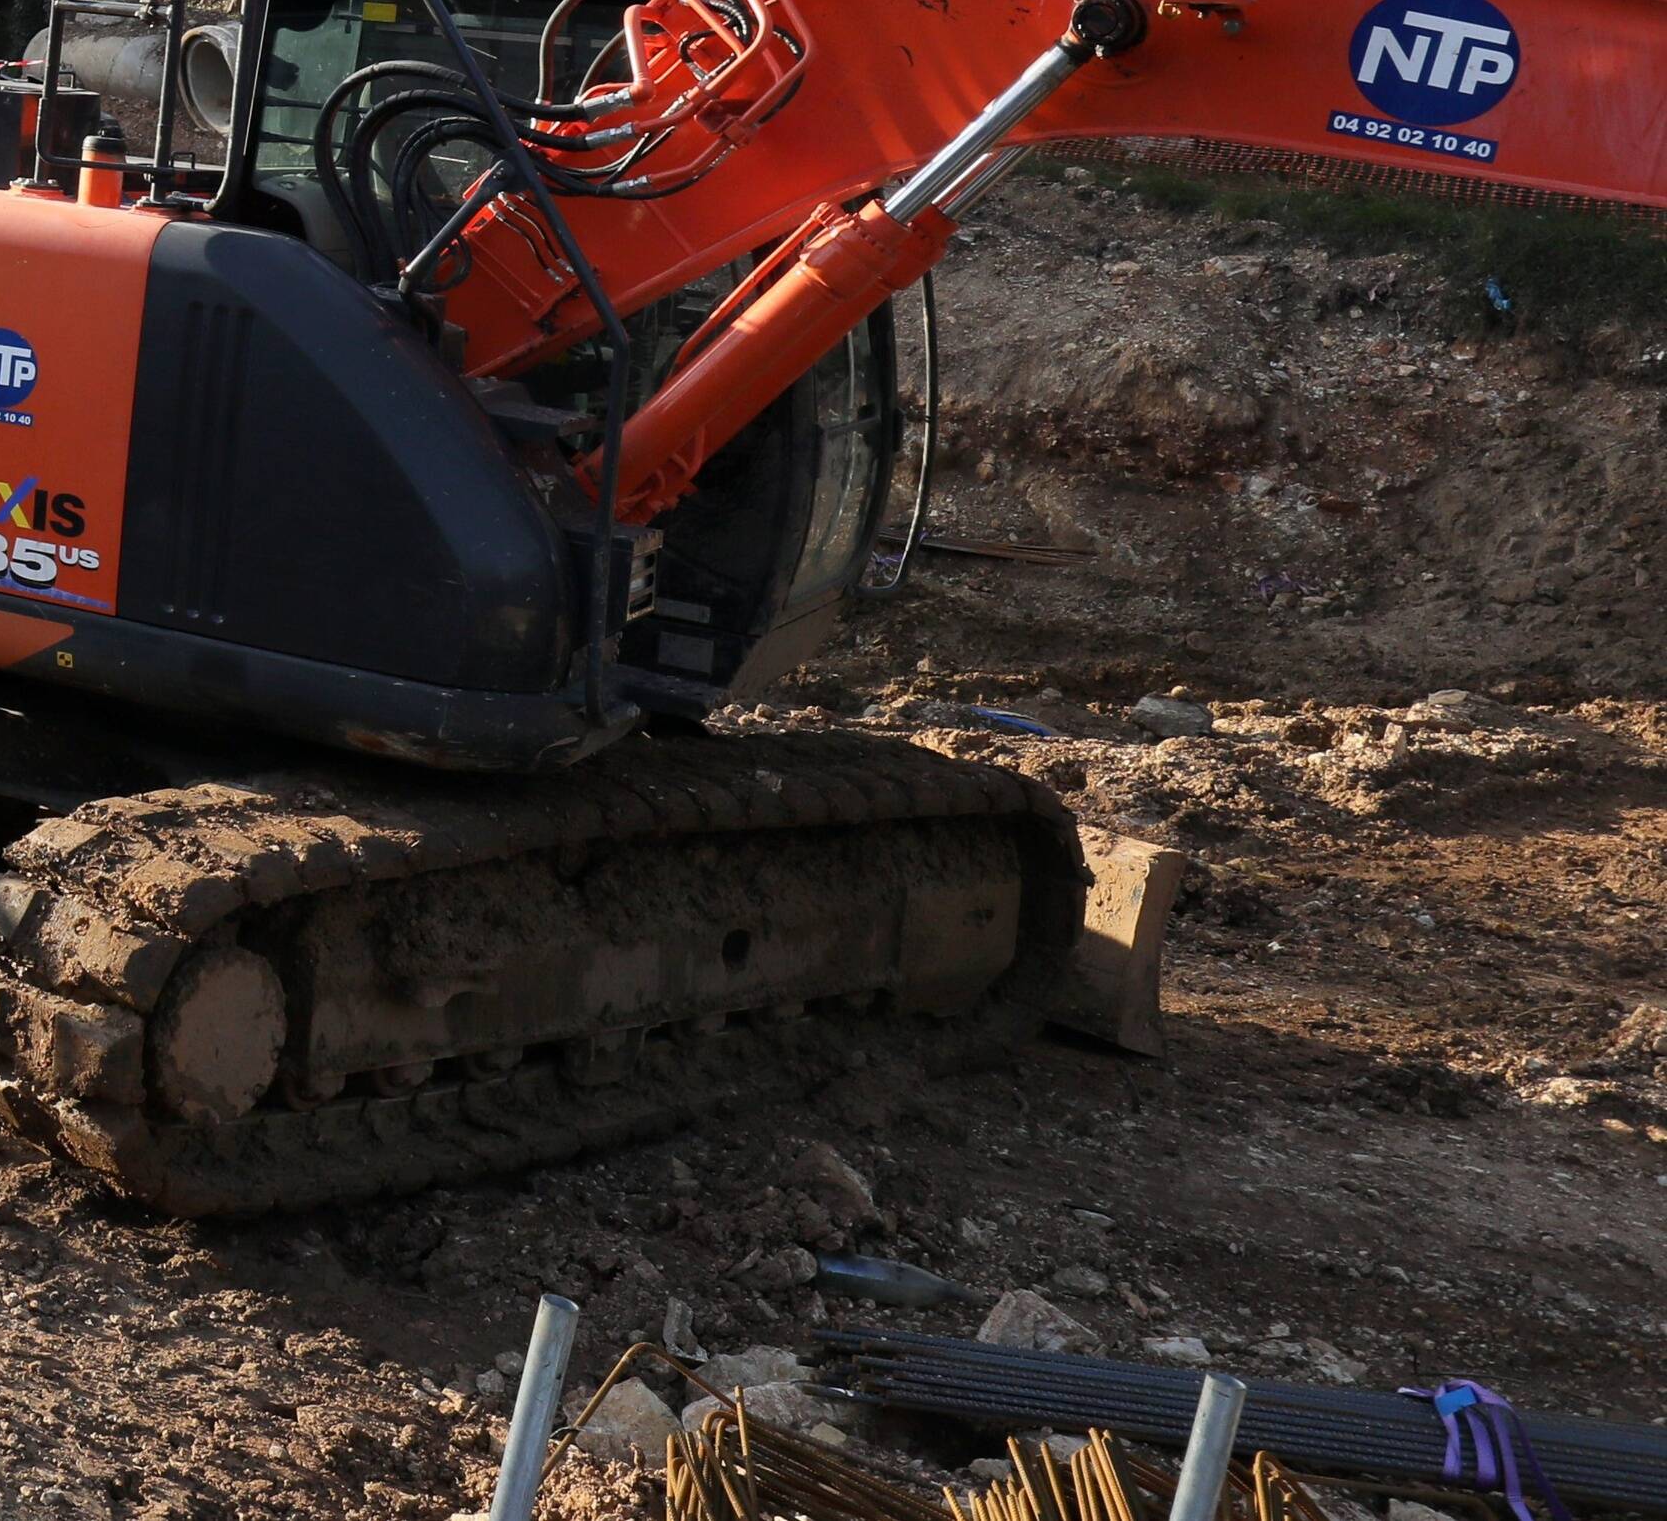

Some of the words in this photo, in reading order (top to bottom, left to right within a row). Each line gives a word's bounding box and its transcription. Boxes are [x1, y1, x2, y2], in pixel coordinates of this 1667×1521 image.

[1357, 10, 1515, 95] NTP
[1333, 115, 1359, 132] 04
[1365, 121, 1391, 139] 92
[1397, 127, 1424, 145] 02
[1431, 134, 1458, 152] 10
[1463, 140, 1491, 158] 40
[3, 411, 17, 423] 10
[18, 414, 31, 425] 40
